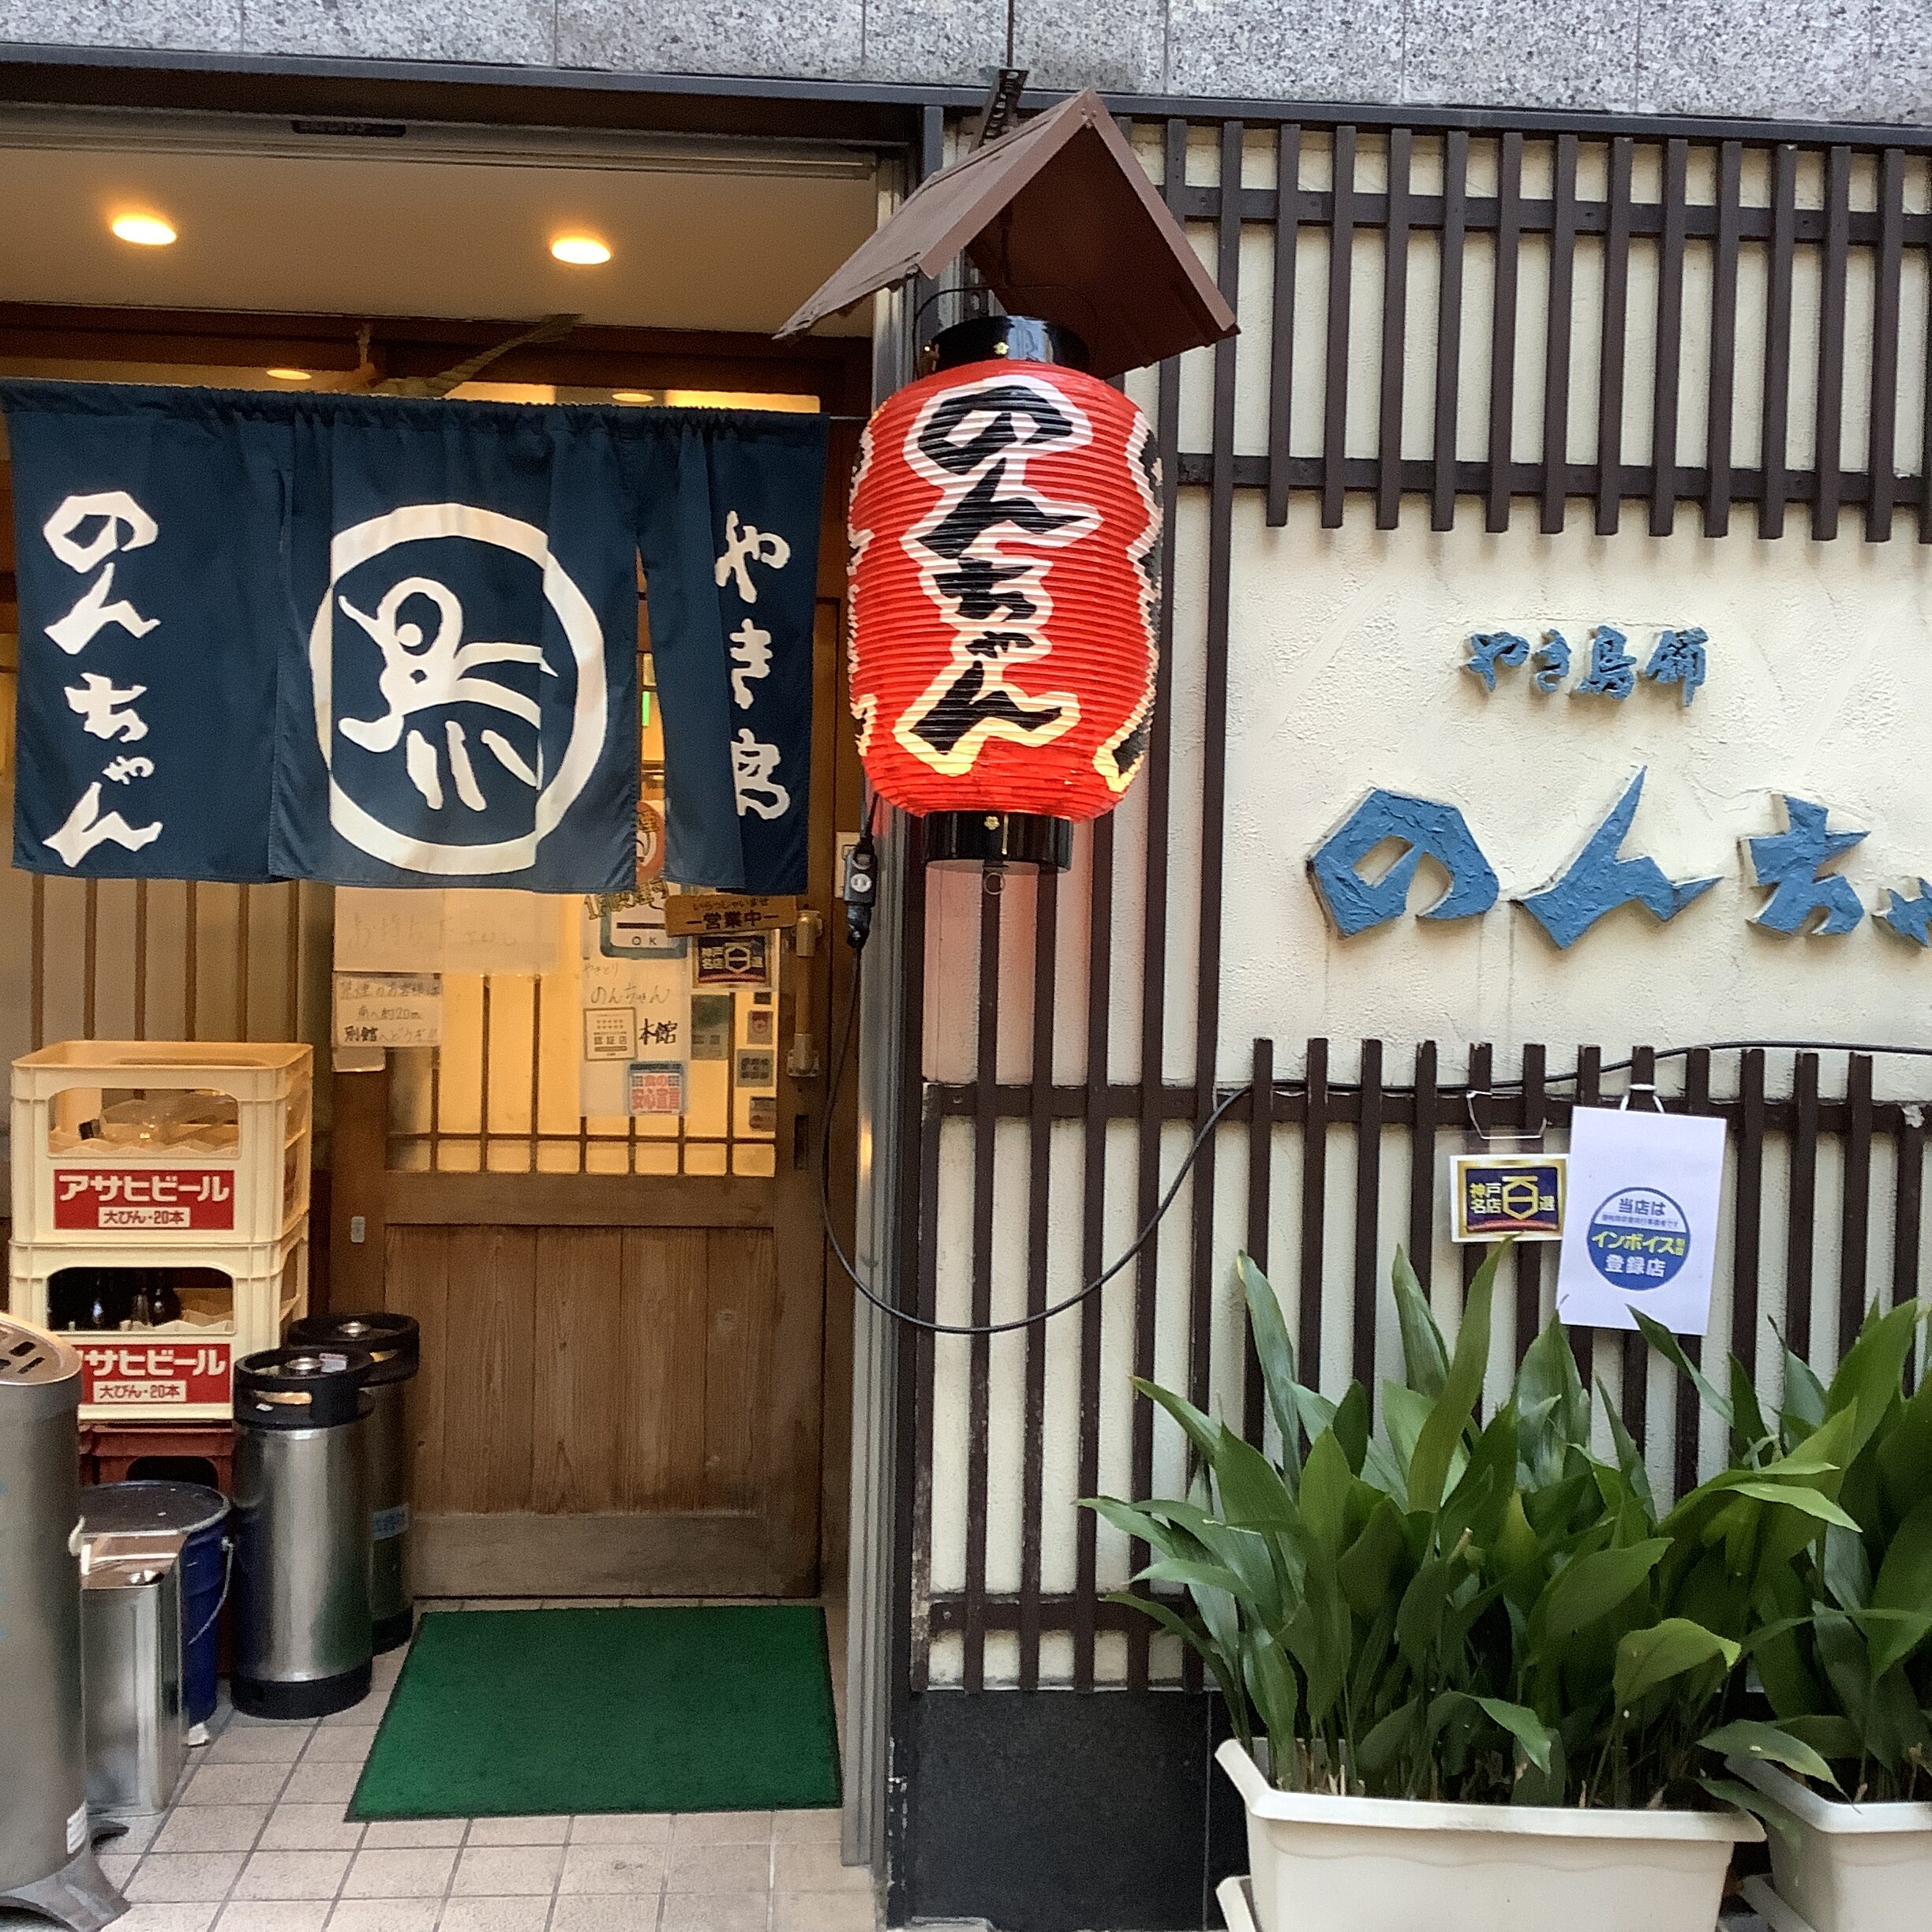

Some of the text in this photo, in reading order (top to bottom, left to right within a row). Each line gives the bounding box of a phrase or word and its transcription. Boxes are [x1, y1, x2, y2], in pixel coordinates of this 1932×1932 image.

[901, 379, 1102, 767] のんちゃん
[43, 490, 163, 869] のんちゃん
[703, 910, 762, 930] 営業中
[638, 1017, 679, 1046] 本館
[58, 1174, 230, 1202] アサヒビール
[103, 1209, 185, 1225] 大びん・20本
[1618, 1198, 1667, 1216] 当店は
[1604, 1253, 1667, 1278] 登録店
[77, 1349, 227, 1376] サヒビール
[99, 1383, 181, 1399] 大びん・20本
